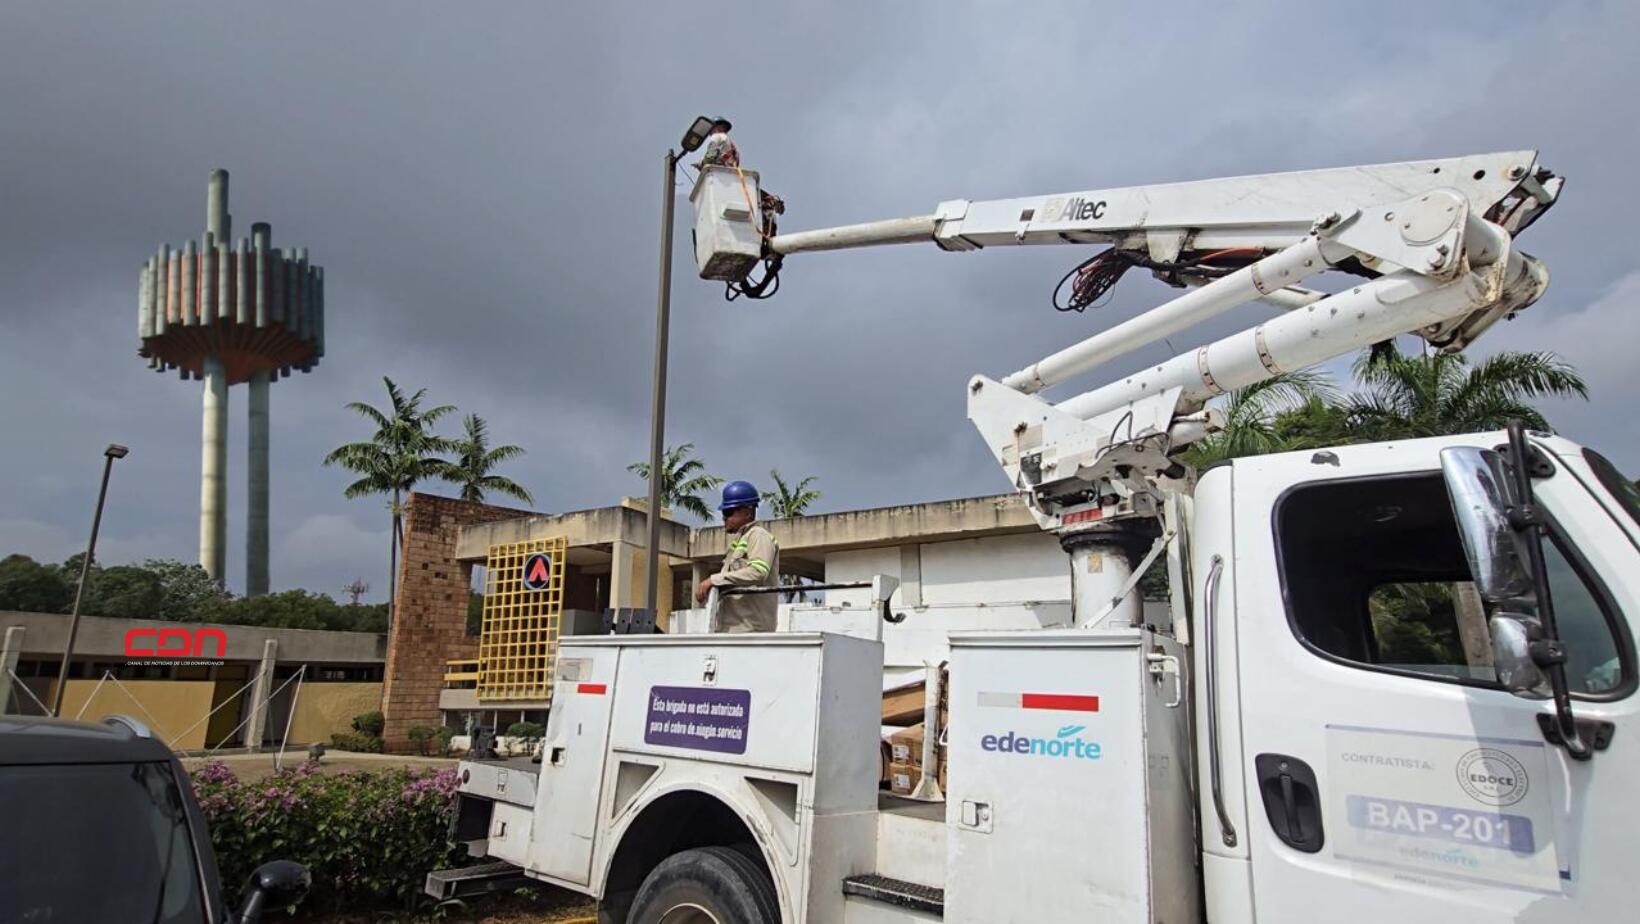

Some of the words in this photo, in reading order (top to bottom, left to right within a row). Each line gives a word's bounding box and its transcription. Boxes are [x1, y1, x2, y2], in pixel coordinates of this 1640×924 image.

[1060, 196, 1107, 221] Altec
[653, 697, 665, 711] Esta
[666, 700, 686, 714] brigada
[688, 703, 695, 713] no
[696, 702, 710, 715] está
[711, 704, 743, 716] autorizada
[650, 722, 662, 734] para
[664, 721, 670, 732] el
[670, 721, 686, 734] cobro
[687, 723, 695, 735] de
[718, 726, 742, 739] servicio
[980, 731, 1101, 759] edenorte
[1470, 774, 1514, 787] EDOCE
[1367, 801, 1512, 845] BAP-201
